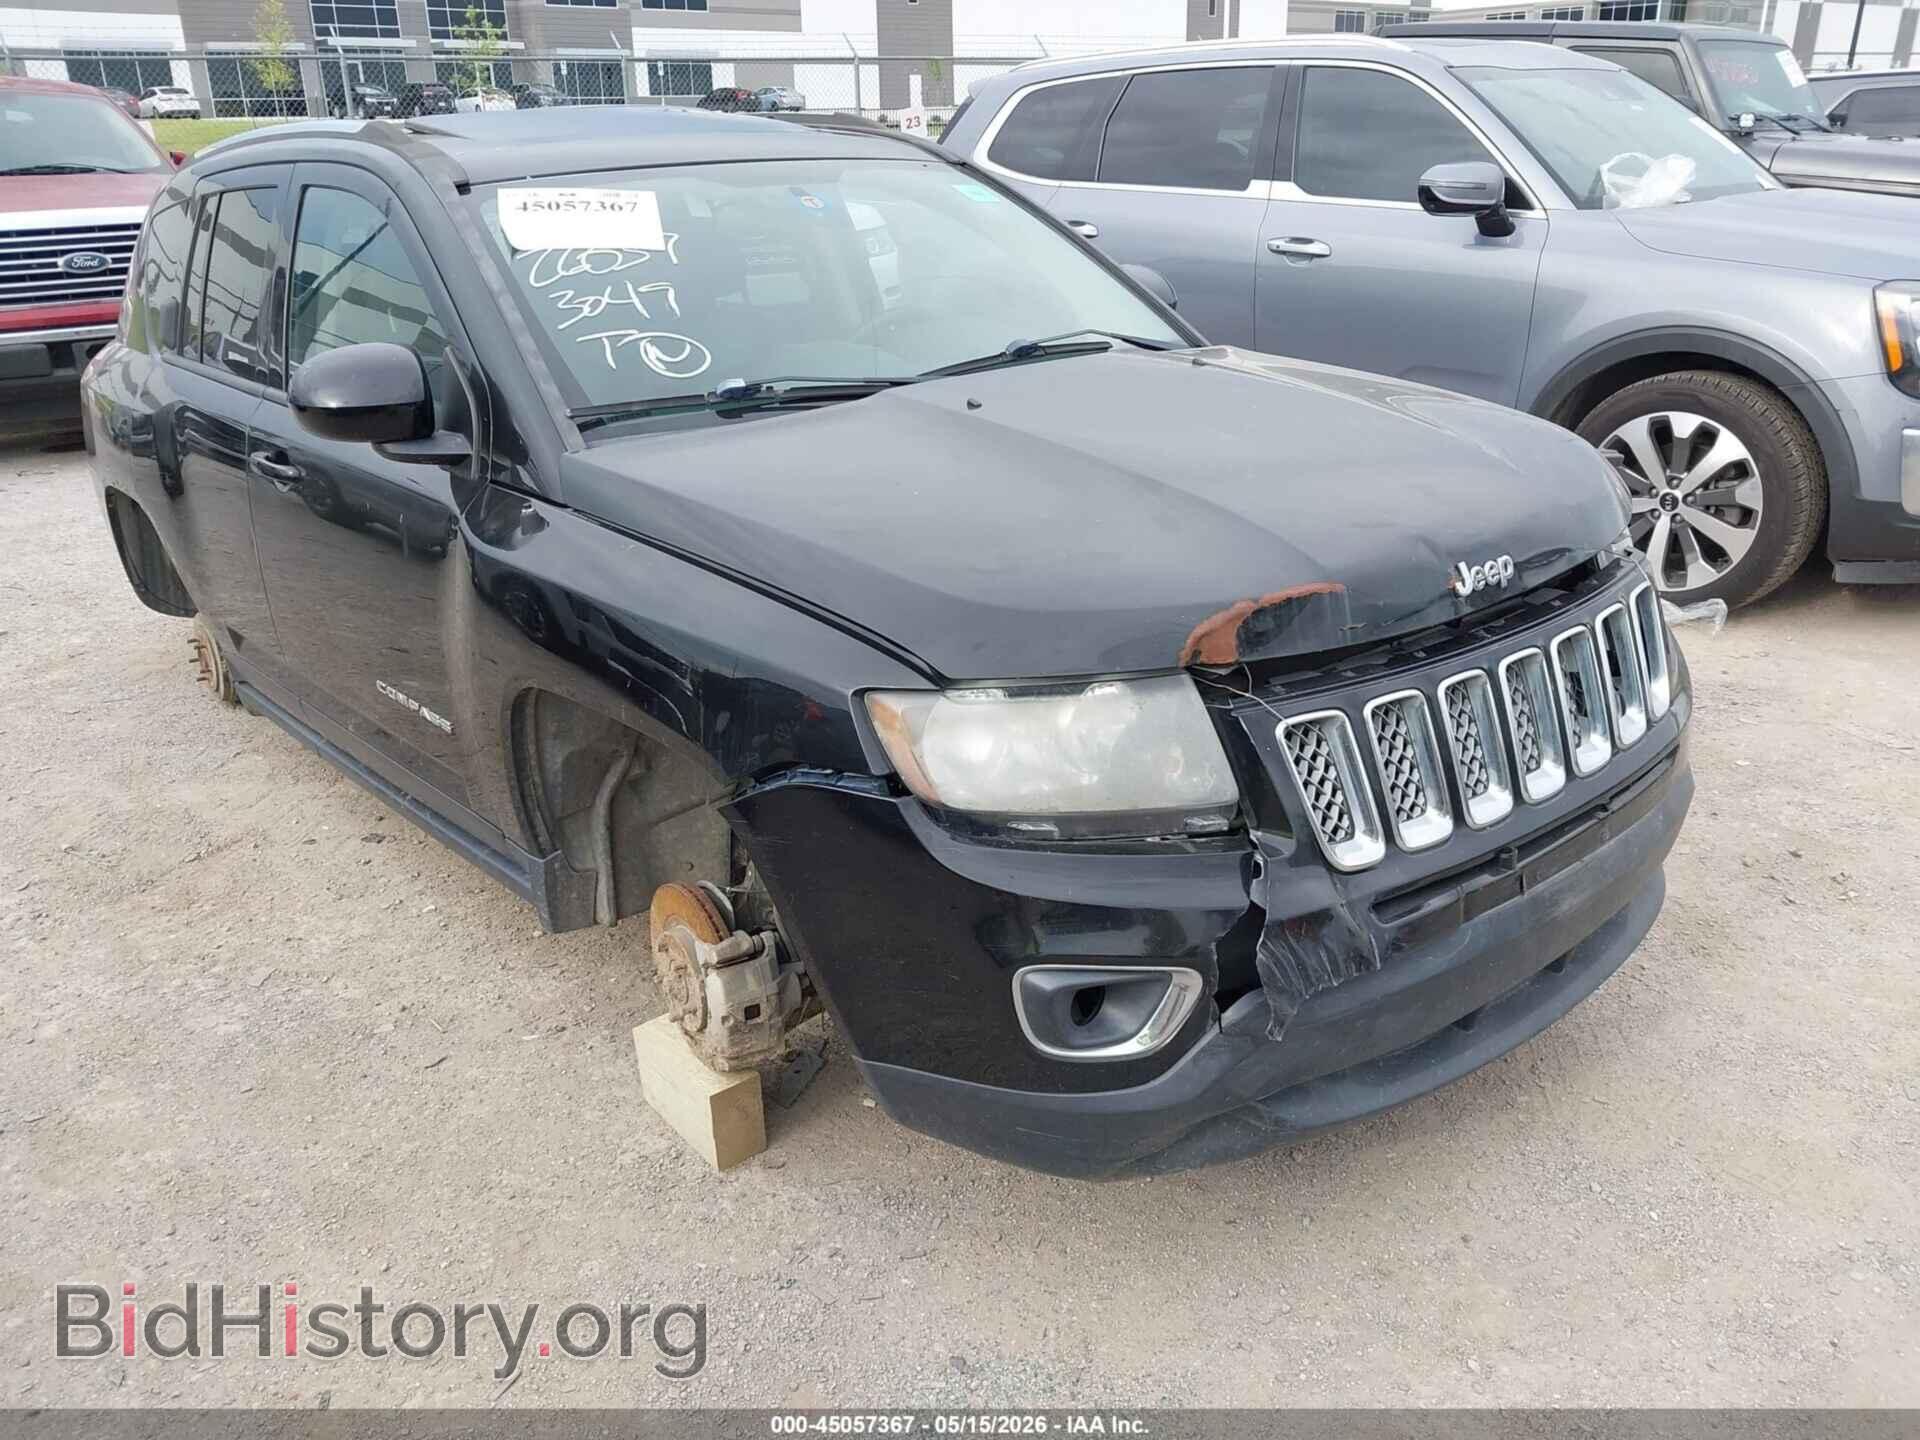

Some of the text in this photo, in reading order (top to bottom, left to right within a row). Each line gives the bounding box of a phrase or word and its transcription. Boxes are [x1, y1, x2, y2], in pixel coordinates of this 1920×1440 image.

[906, 115, 921, 129] 23
[514, 201, 638, 213] 45057367
[72, 256, 100, 268] Ford
[1455, 555, 1514, 597] Jeep
[376, 680, 454, 734] COMPASS
